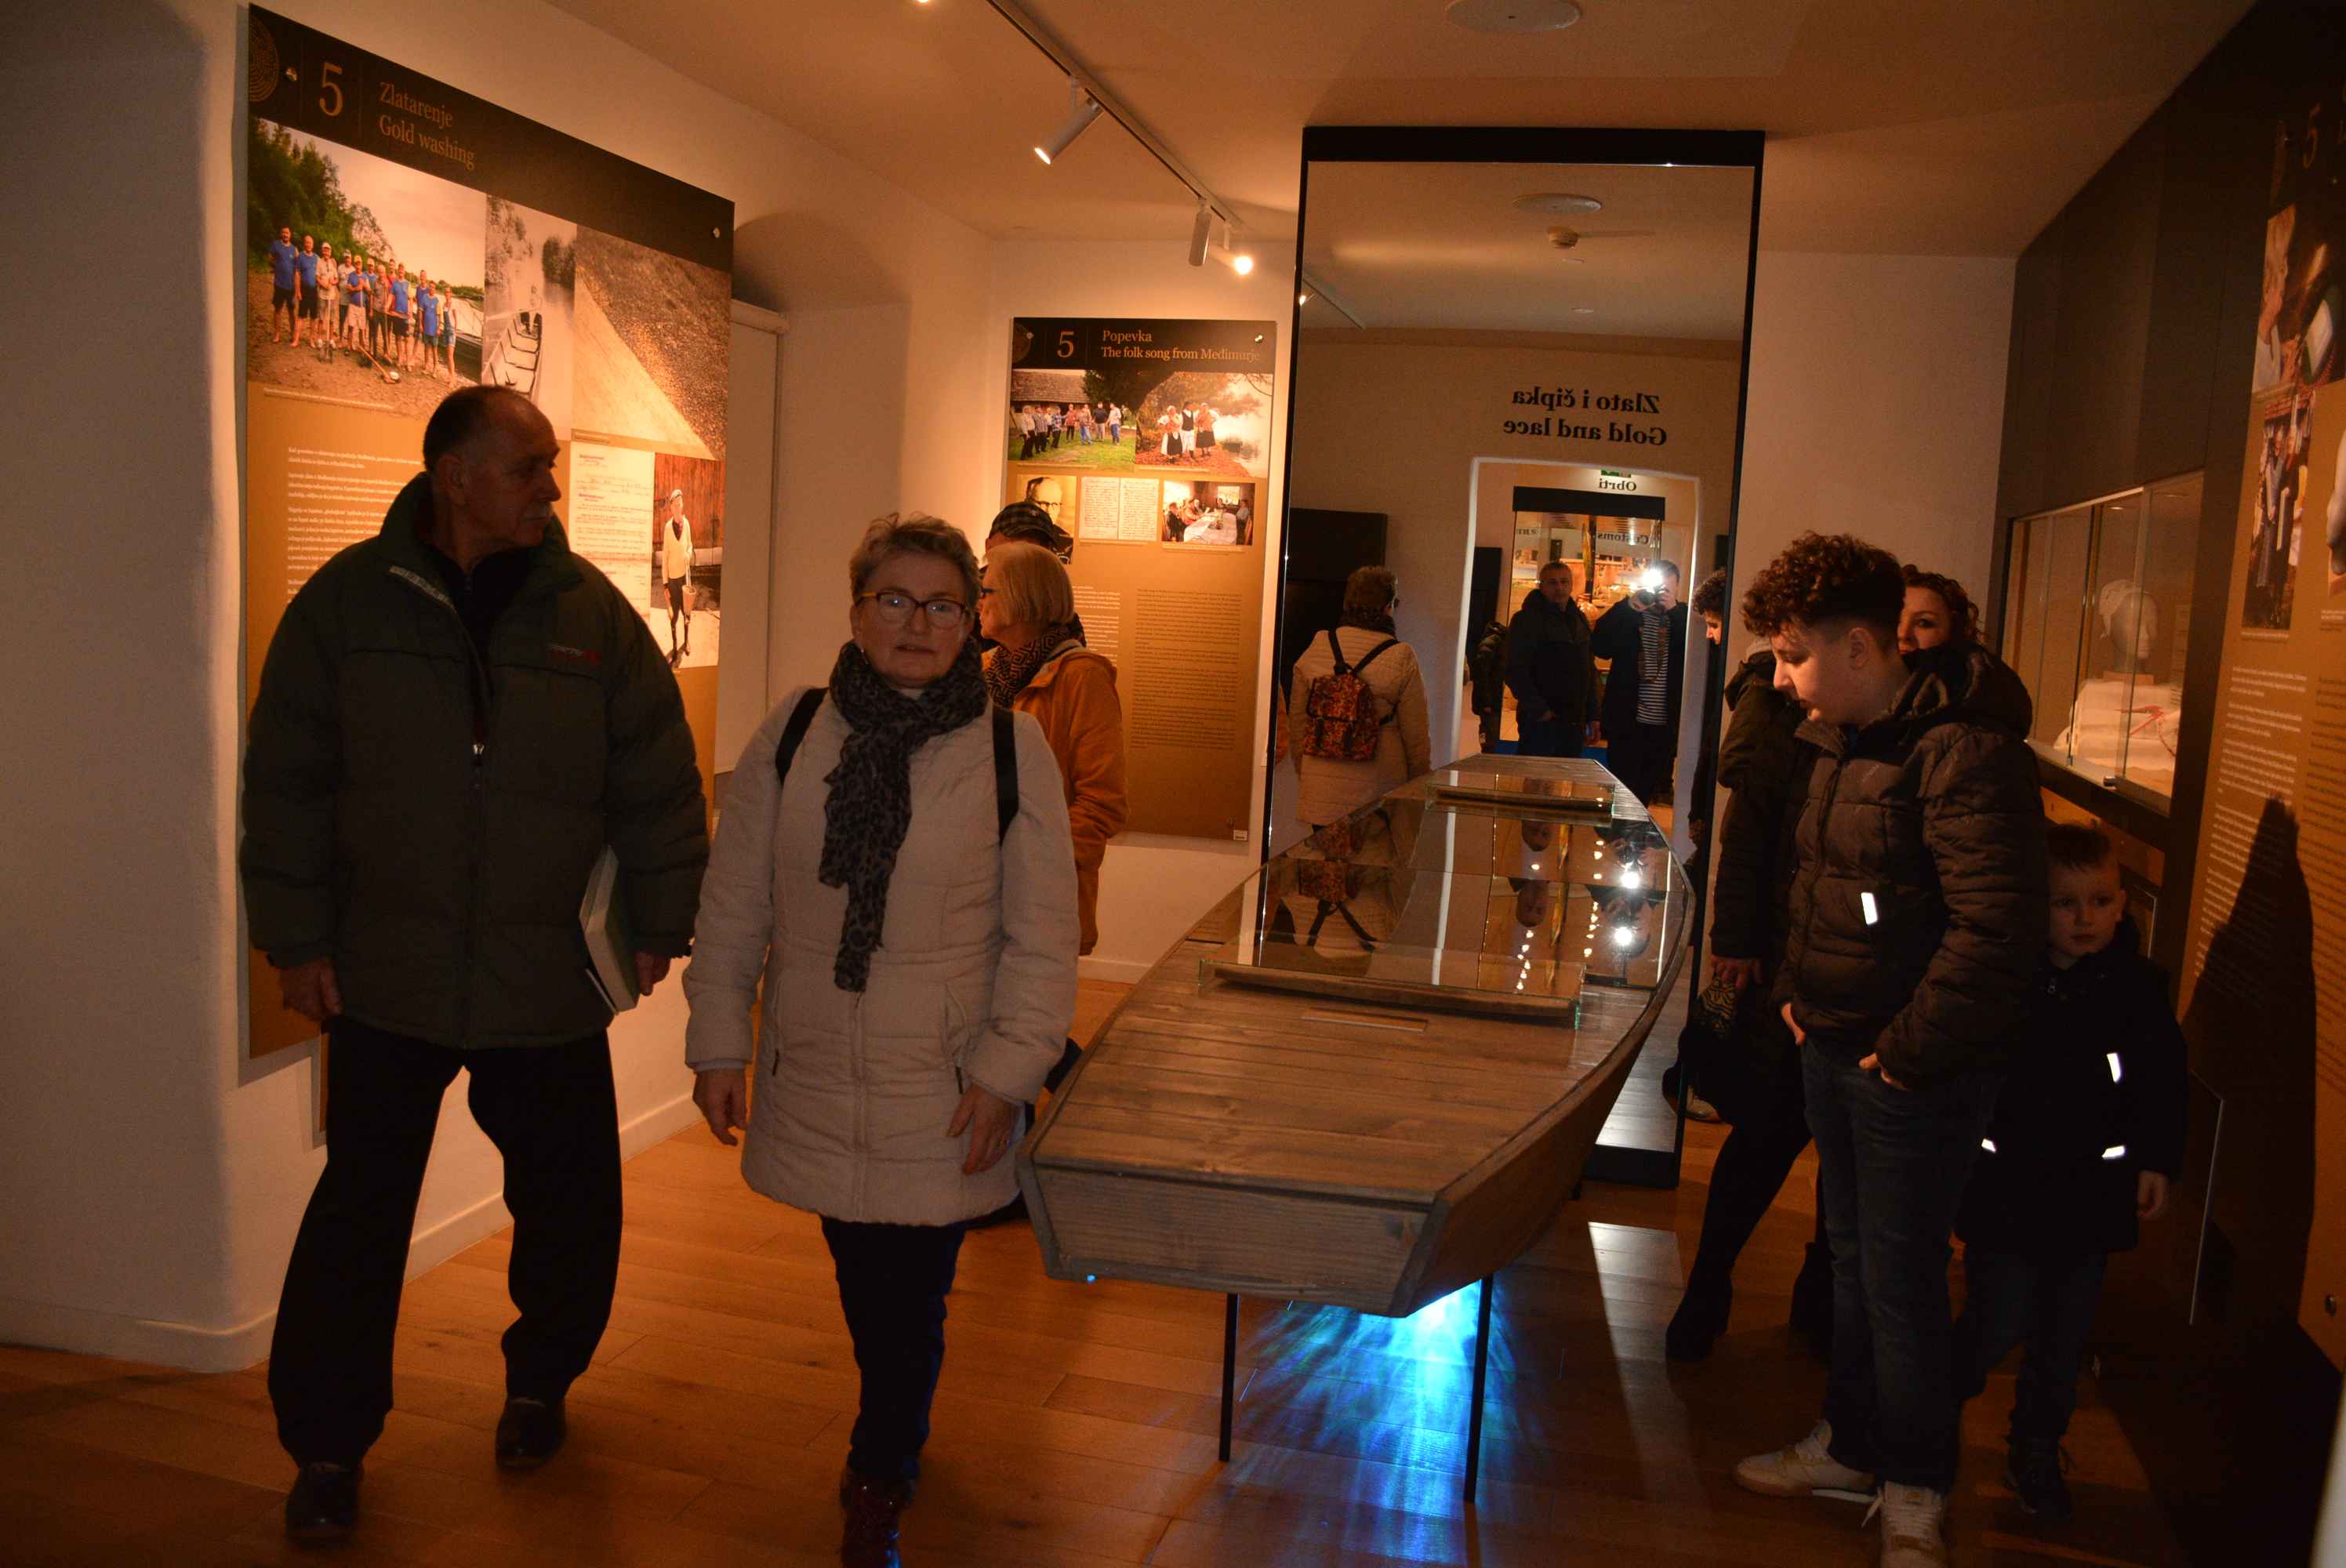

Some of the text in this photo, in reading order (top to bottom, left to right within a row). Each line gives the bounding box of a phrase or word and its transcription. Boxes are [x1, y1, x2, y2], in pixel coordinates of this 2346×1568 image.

[319, 62, 343, 117] 5
[379, 82, 453, 129] Zlatarenje
[379, 114, 477, 170] Gold washing
[1057, 331, 1074, 358] 5
[1101, 346, 1122, 358] The
[1123, 347, 1142, 358] folk
[1145, 350, 1171, 361] song
[1172, 347, 1198, 359] from
[1102, 329, 1153, 344] Popevka
